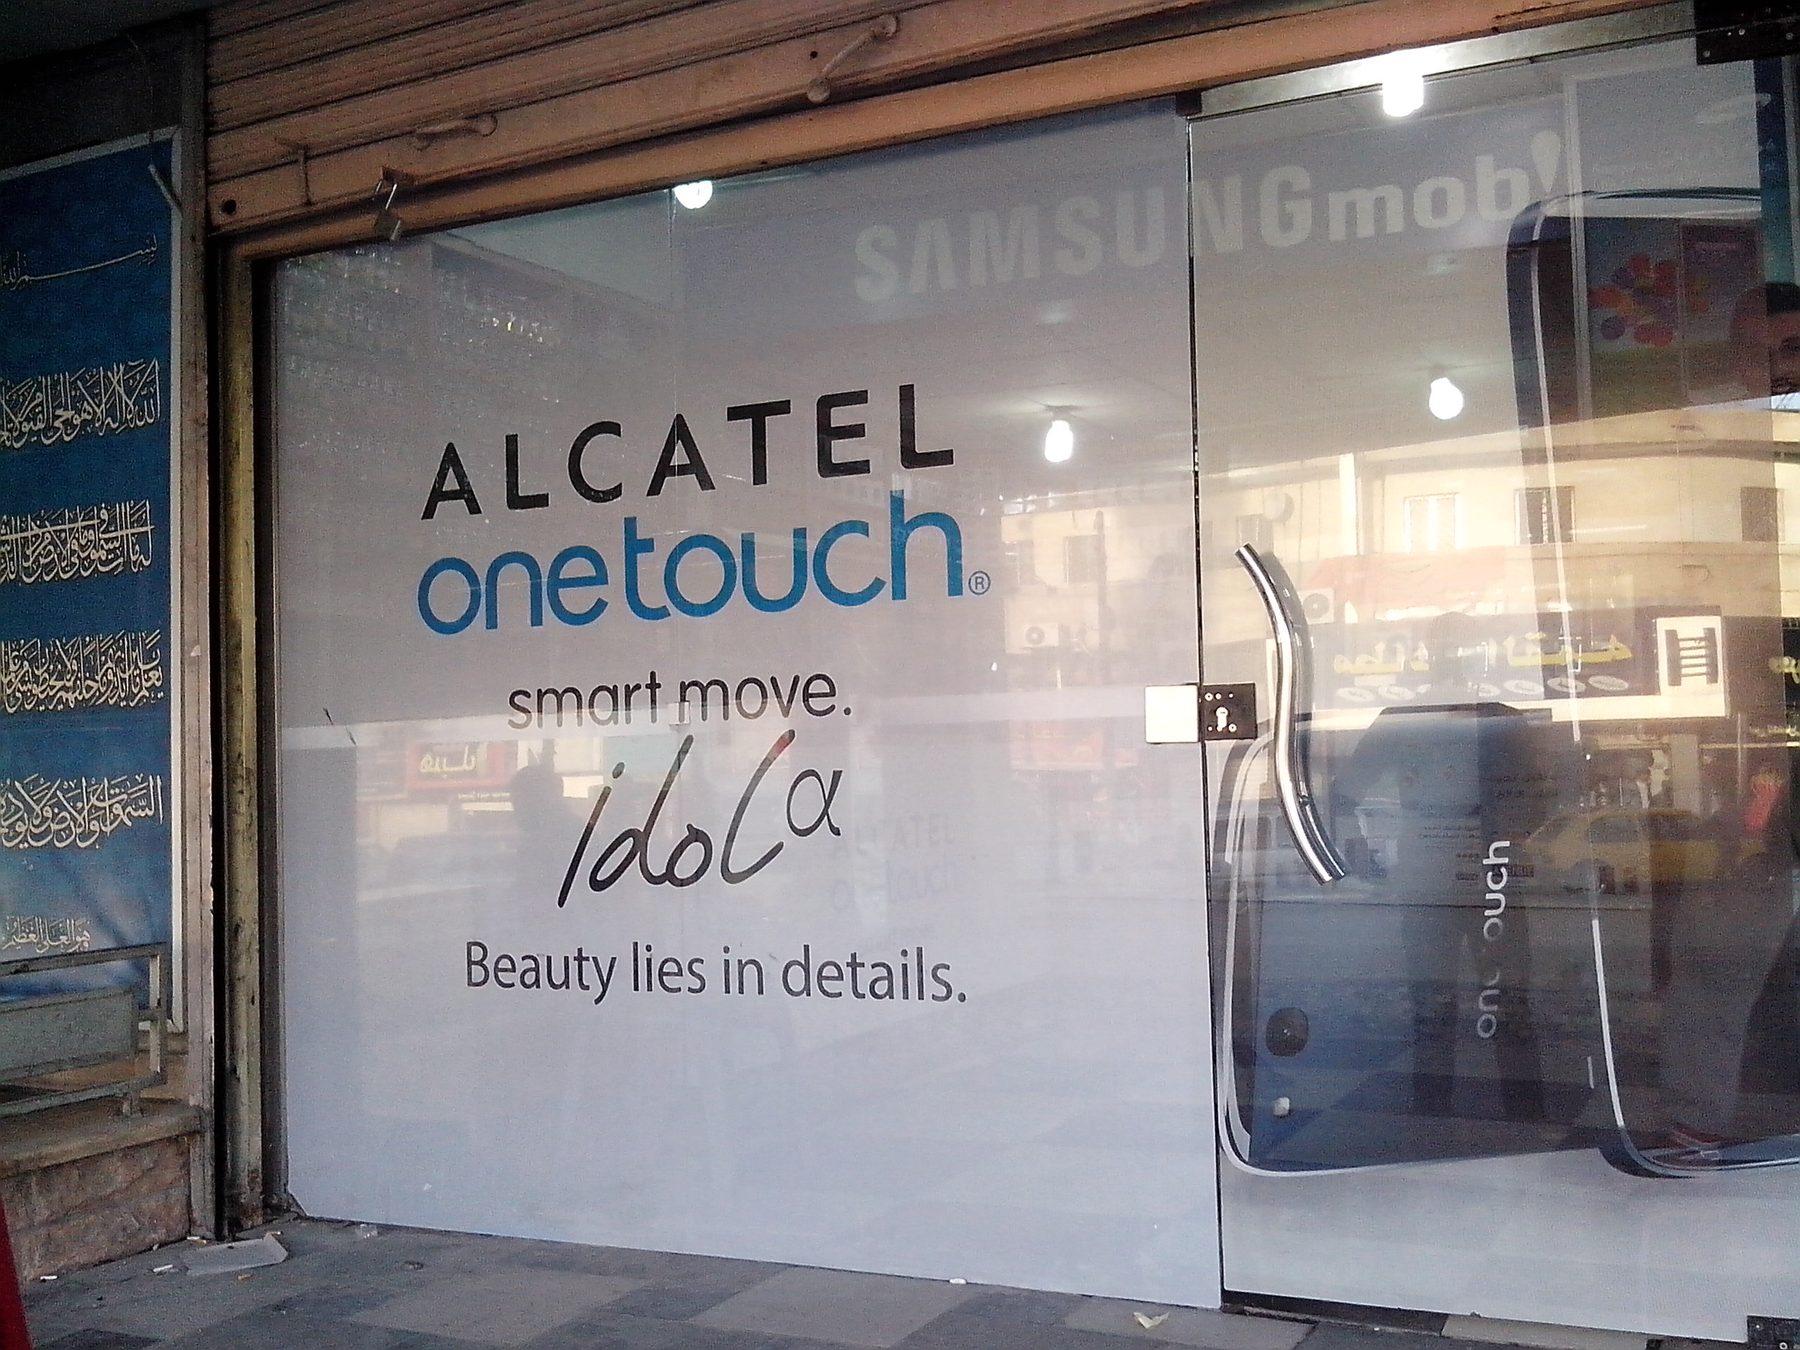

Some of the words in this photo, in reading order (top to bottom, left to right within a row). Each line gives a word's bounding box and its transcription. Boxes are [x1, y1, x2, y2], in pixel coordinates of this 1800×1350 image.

[420, 383, 955, 521] ALCATEL
[508, 670, 662, 730] smart
[678, 672, 852, 721] move.
[466, 941, 617, 1006] Beauty
[632, 941, 706, 994] lies
[723, 945, 764, 996] in
[782, 944, 967, 1003] details.
